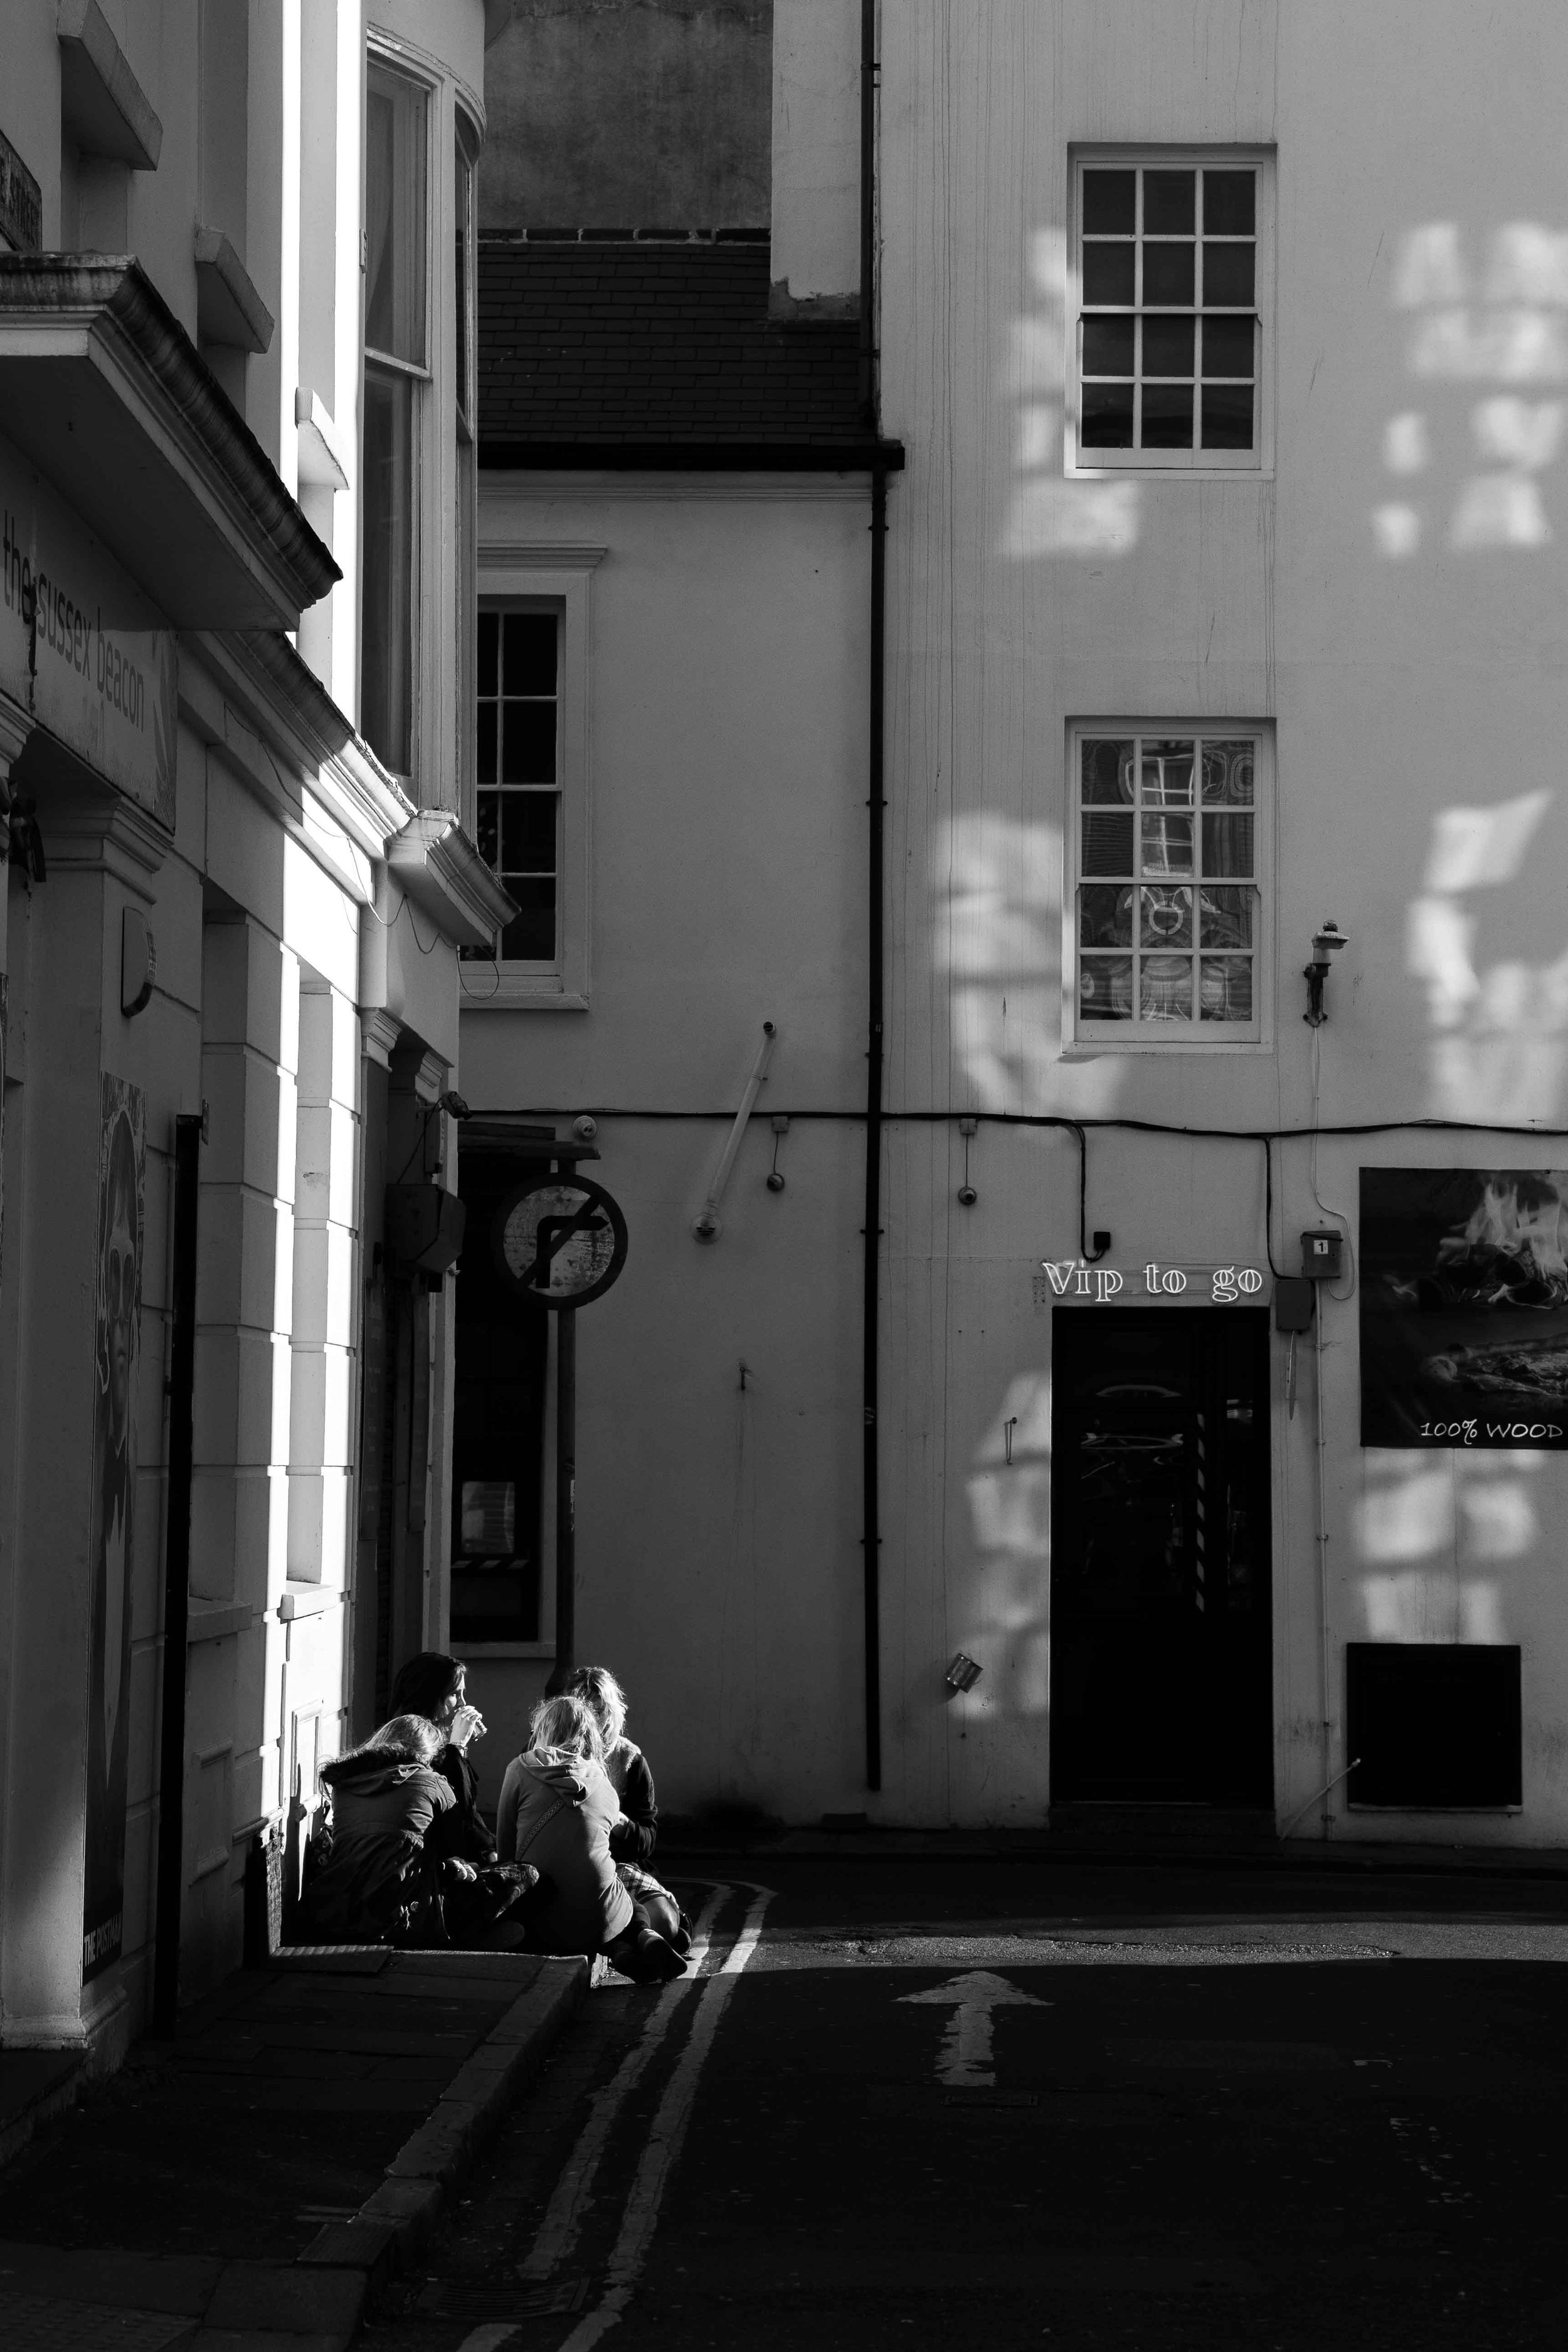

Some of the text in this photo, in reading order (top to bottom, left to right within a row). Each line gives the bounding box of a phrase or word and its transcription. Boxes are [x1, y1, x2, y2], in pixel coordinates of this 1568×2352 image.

[3, 509, 146, 734] the sussex beacon
[1318, 1242, 1324, 1253] 1
[1042, 1258, 1263, 1303] Vip to go
[1420, 1418, 1564, 1445] 100% WOOD
[84, 1929, 96, 1968] THE
